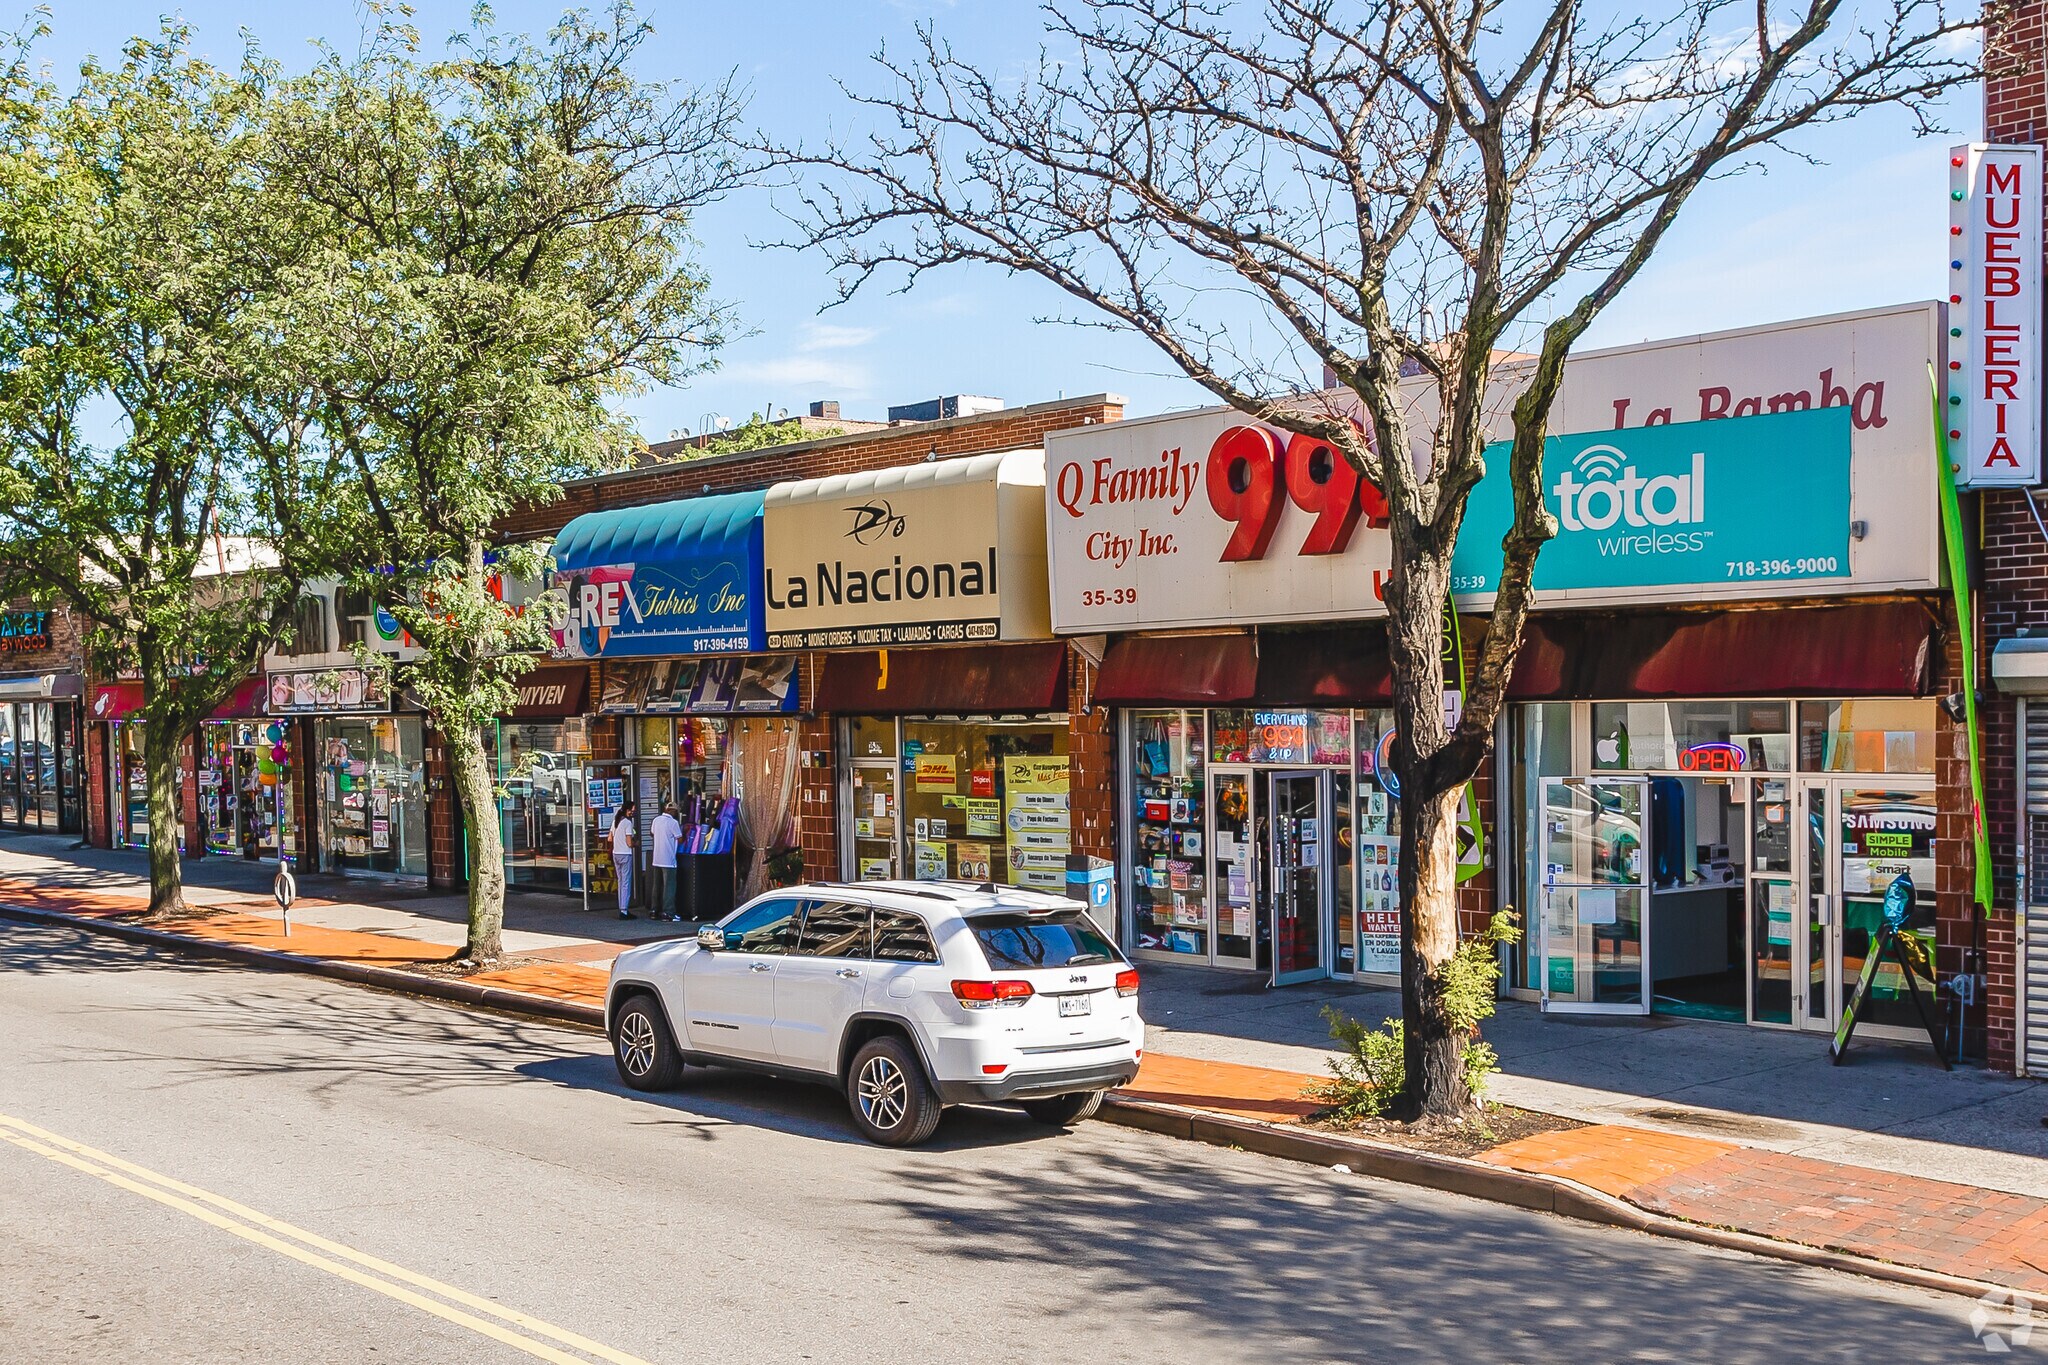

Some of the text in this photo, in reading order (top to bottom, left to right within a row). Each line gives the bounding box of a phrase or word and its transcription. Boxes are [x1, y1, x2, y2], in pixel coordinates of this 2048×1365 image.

[1983, 163, 2022, 468] MUEBLERIA
[1057, 446, 1200, 518] Q Family
[1553, 453, 1705, 532] total
[1086, 528, 1178, 569] City Inc.
[1726, 556, 1838, 577] 718-396-9000
[766, 547, 998, 610] La Nacional
[1453, 575, 1487, 590] 35-39
[640, 581, 746, 619] Fabrics Inc
[1082, 587, 1137, 606] 35-39
[693, 637, 749, 652] 917-396-4159
[782, 634, 803, 649] ENVIOS
[808, 632, 828, 647] MONEY
[828, 631, 852, 646] ORDERS
[857, 629, 879, 644] INCOME
[880, 628, 893, 642] TAX
[897, 625, 931, 642] LLAMADAS
[937, 624, 964, 640] CARGAS
[1255, 713, 1307, 726] EVERYTHING
[1269, 748, 1292, 760] & UP
[1679, 749, 1740, 771] OPEN
[922, 764, 949, 774] DHL
[1869, 835, 1909, 845] SIMPLE
[1870, 847, 1908, 857] Mobile
[1876, 865, 1911, 875] smart
[1097, 884, 1107, 903] P
[1366, 913, 1400, 924] HEL
